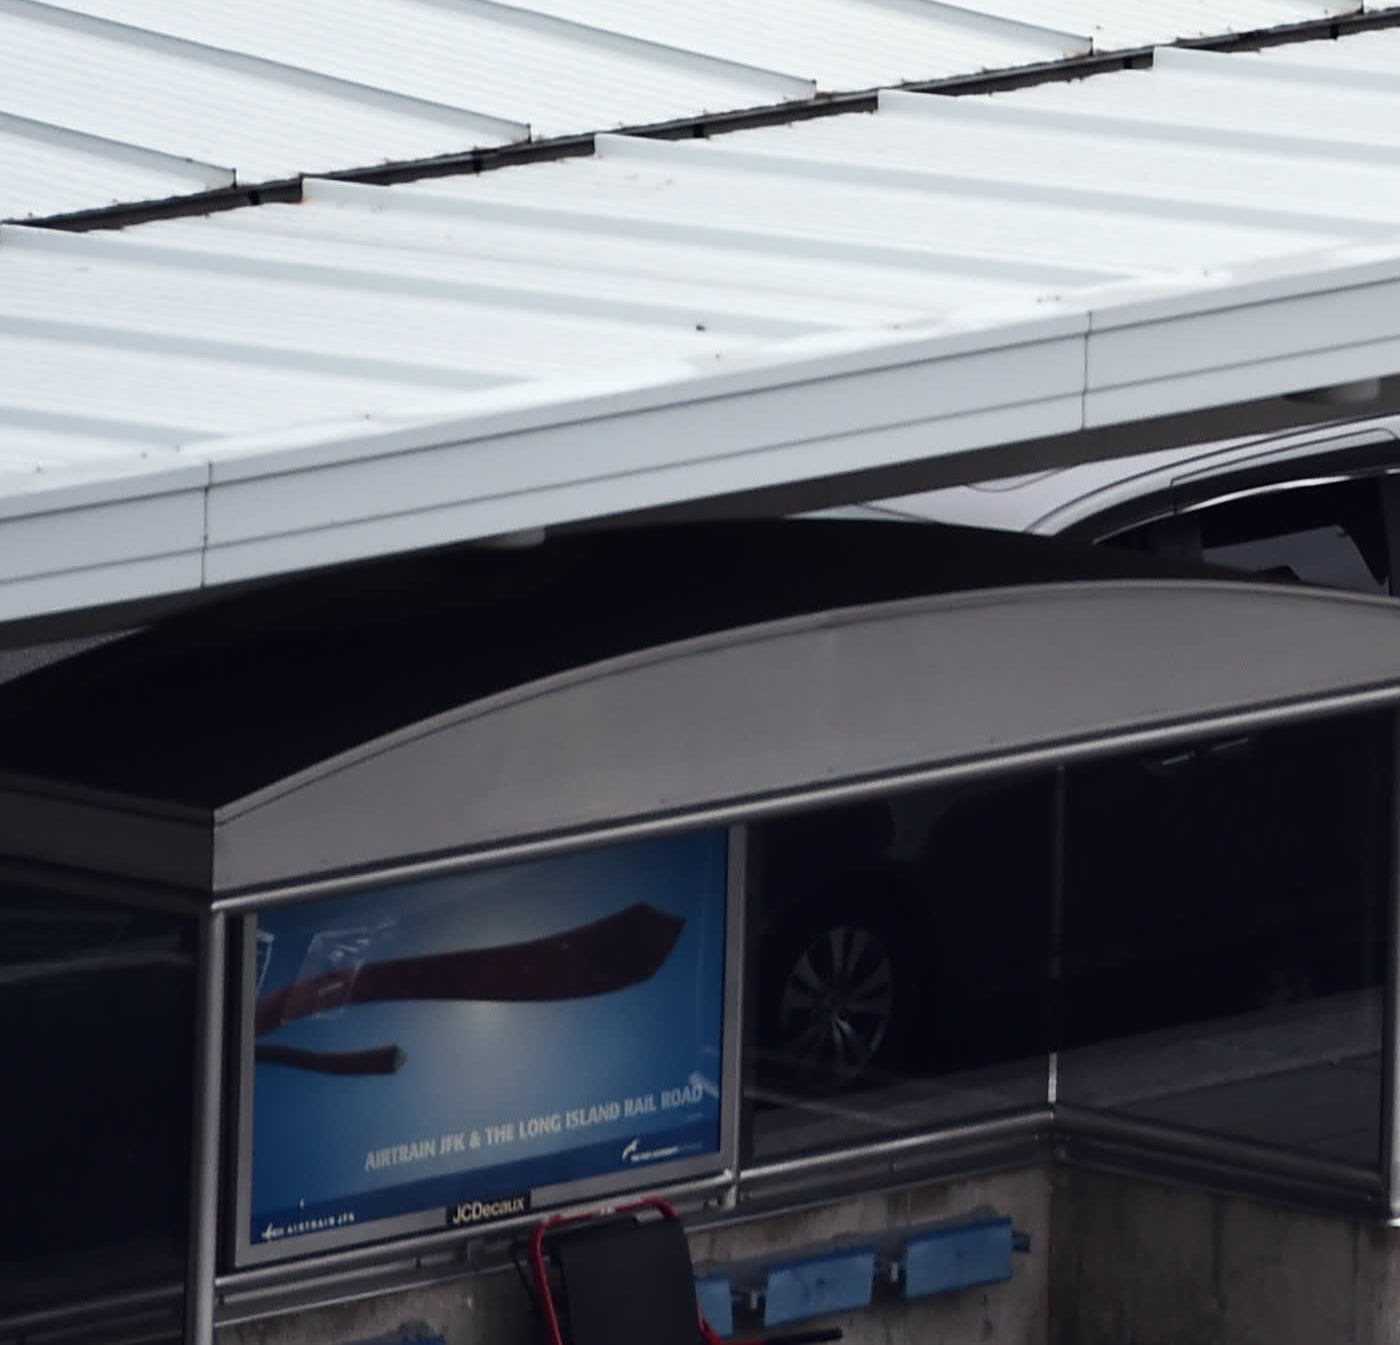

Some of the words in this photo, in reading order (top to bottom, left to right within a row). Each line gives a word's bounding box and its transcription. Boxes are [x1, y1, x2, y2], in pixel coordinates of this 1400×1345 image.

[364, 1137, 438, 1172] AIRTRAIN
[439, 1132, 466, 1157] JFK
[468, 1130, 482, 1150] &
[485, 1122, 515, 1148] THE
[518, 1113, 562, 1140] LONG
[565, 1100, 621, 1130] ISLAND
[623, 1093, 658, 1118] RAIL
[660, 1084, 705, 1109] ROAD
[452, 1197, 525, 1224] JCDecaux
